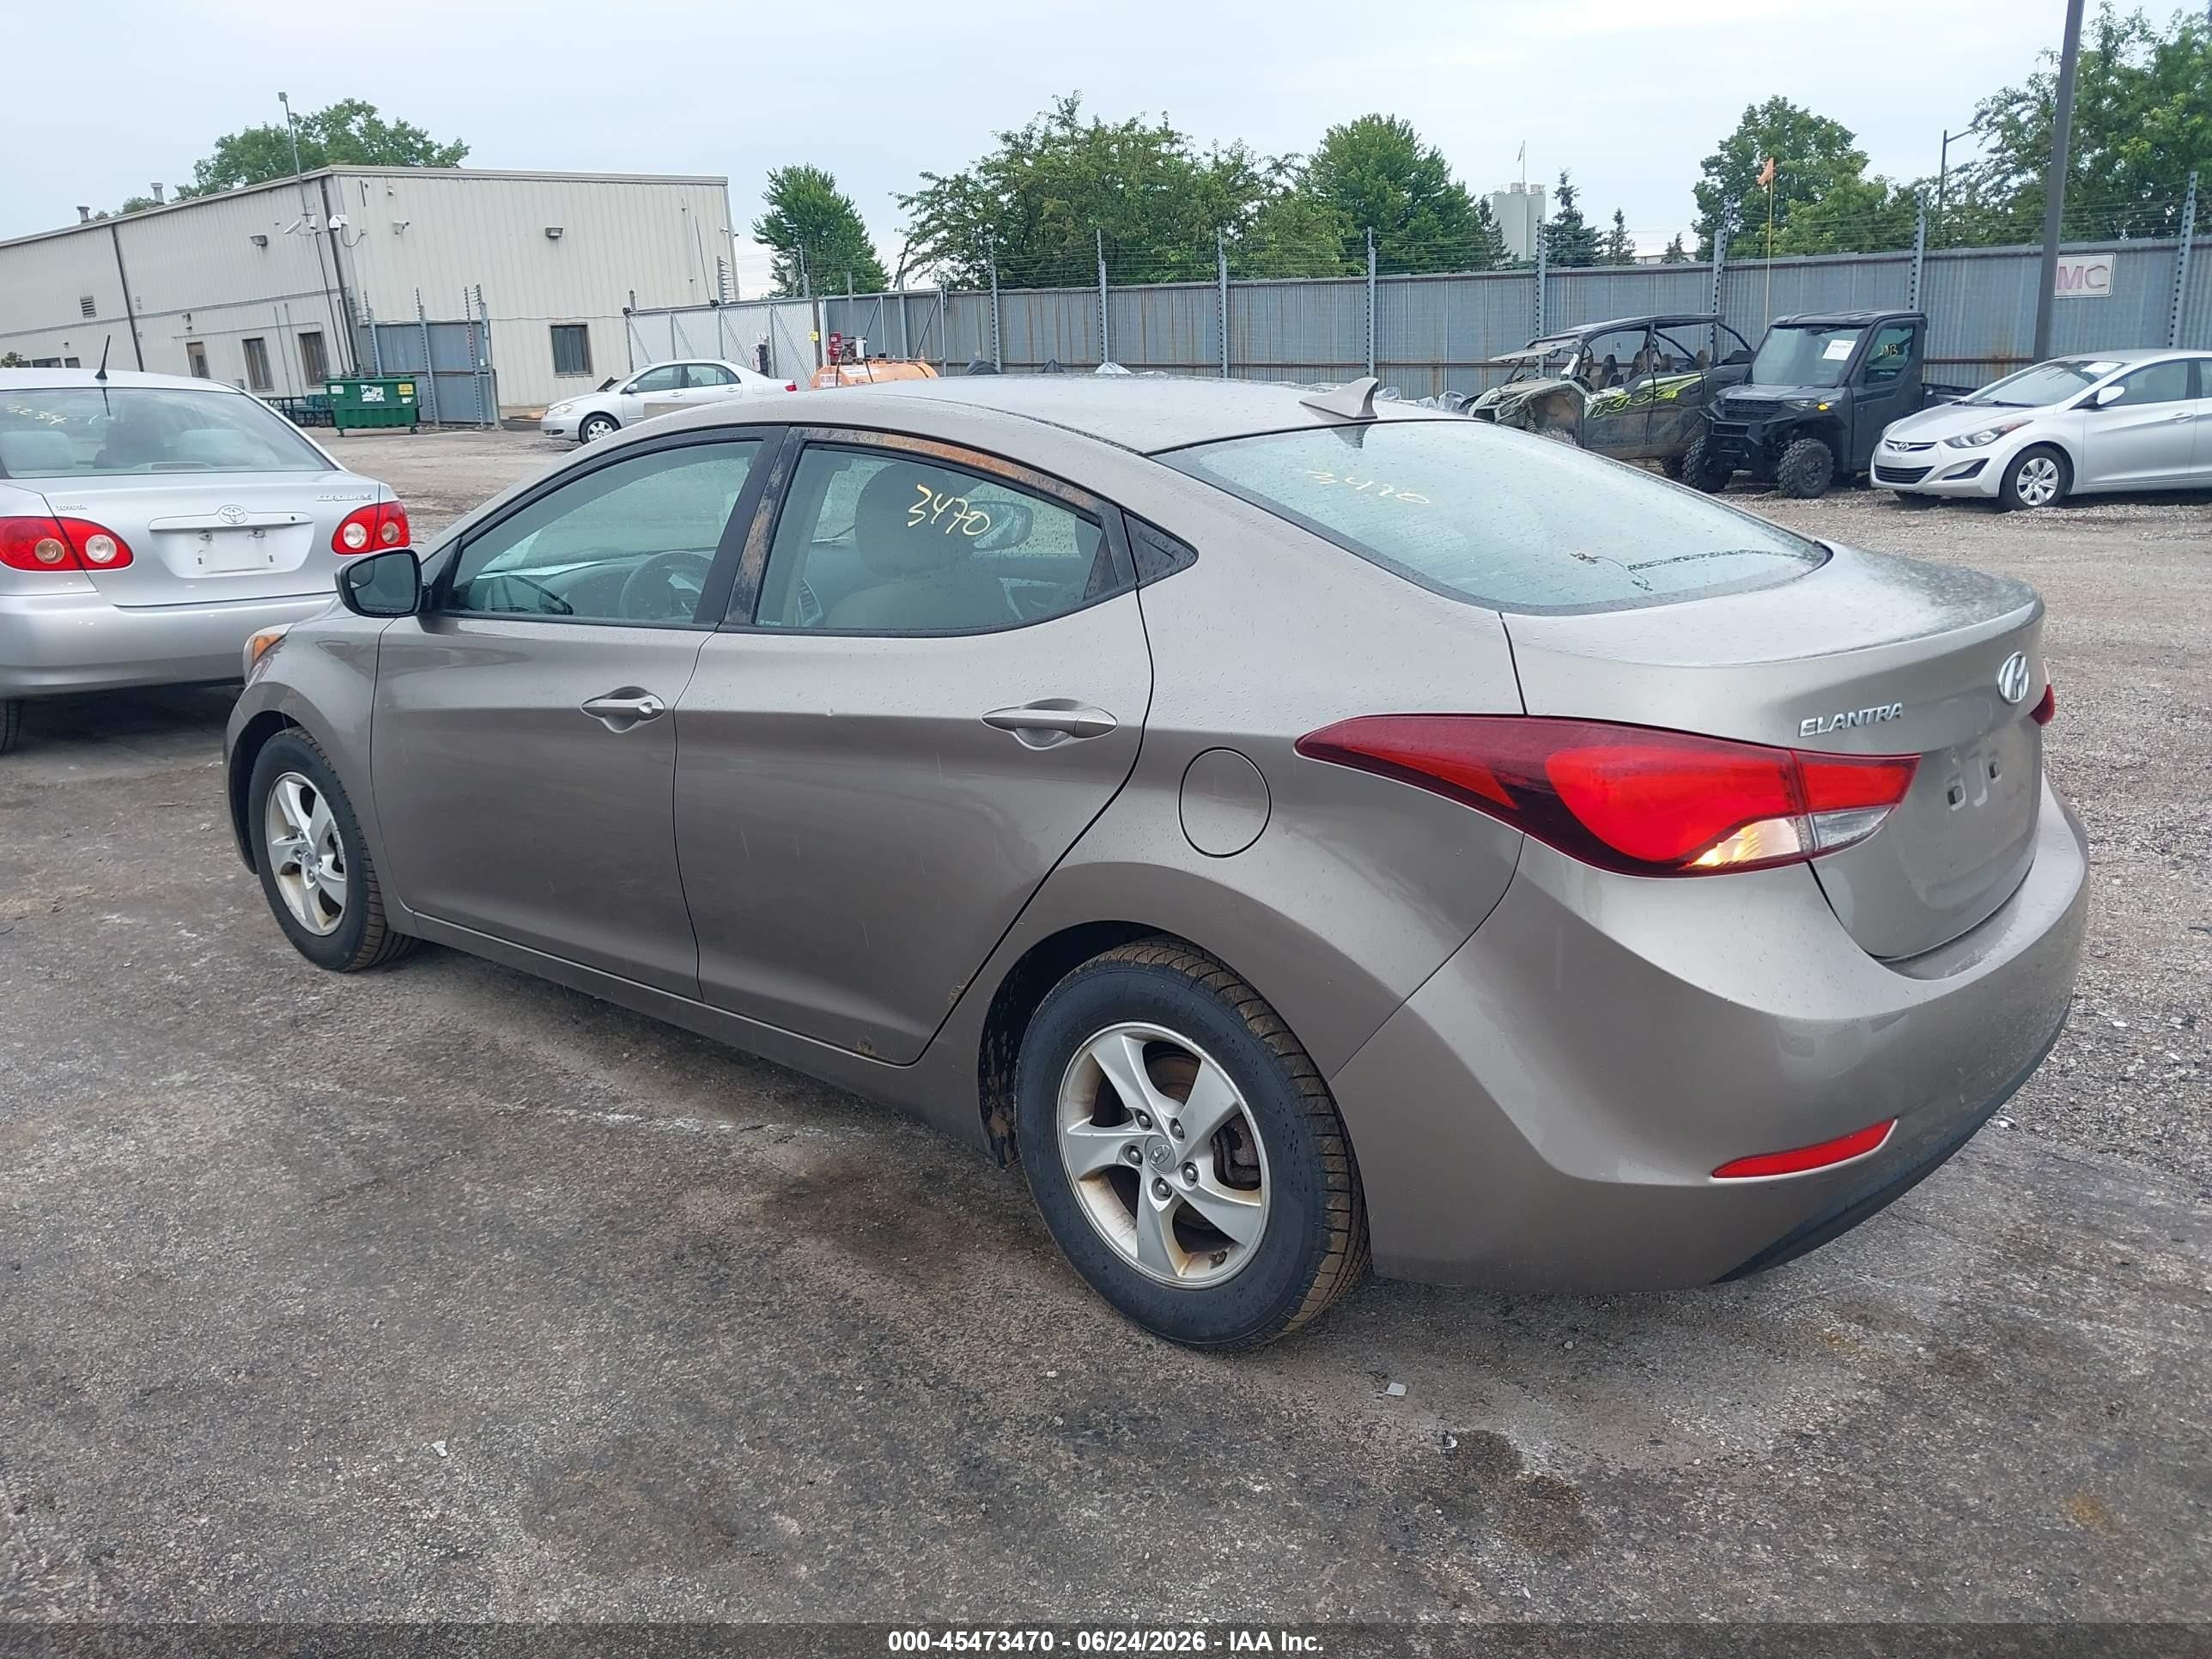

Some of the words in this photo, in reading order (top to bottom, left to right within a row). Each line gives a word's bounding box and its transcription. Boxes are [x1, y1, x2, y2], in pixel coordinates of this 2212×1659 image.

[1304, 471, 1430, 504] 3470
[907, 483, 991, 536] 3470
[1798, 702, 1903, 738] ELANTRA
